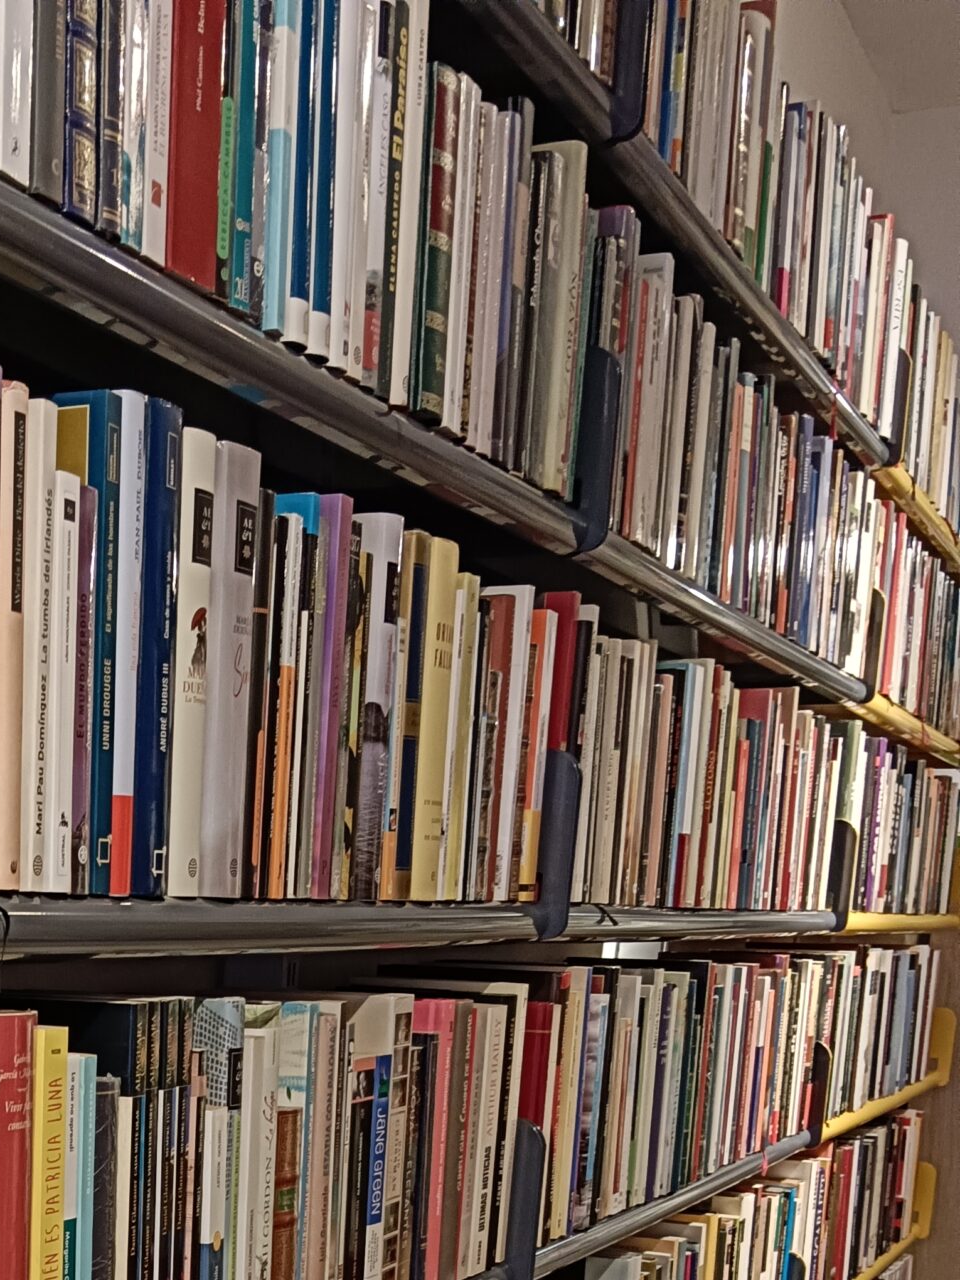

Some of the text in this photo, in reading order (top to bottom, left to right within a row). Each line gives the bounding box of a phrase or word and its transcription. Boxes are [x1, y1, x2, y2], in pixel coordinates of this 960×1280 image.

[392, 135, 402, 162] El
[43, 487, 54, 555] irlandés
[42, 588, 50, 639] tumba
[41, 650, 47, 665] La
[37, 674, 48, 762] Domínguez
[102, 657, 112, 751] UNNI DROUGGE
[159, 663, 169, 752] ANDRÉ DUBUS III
[36, 766, 45, 796] Pau
[35, 802, 44, 836] Mari
[48, 1077, 63, 1123] LUNA
[45, 1134, 61, 1215] PATRICIA
[45, 1224, 59, 1245] ES
